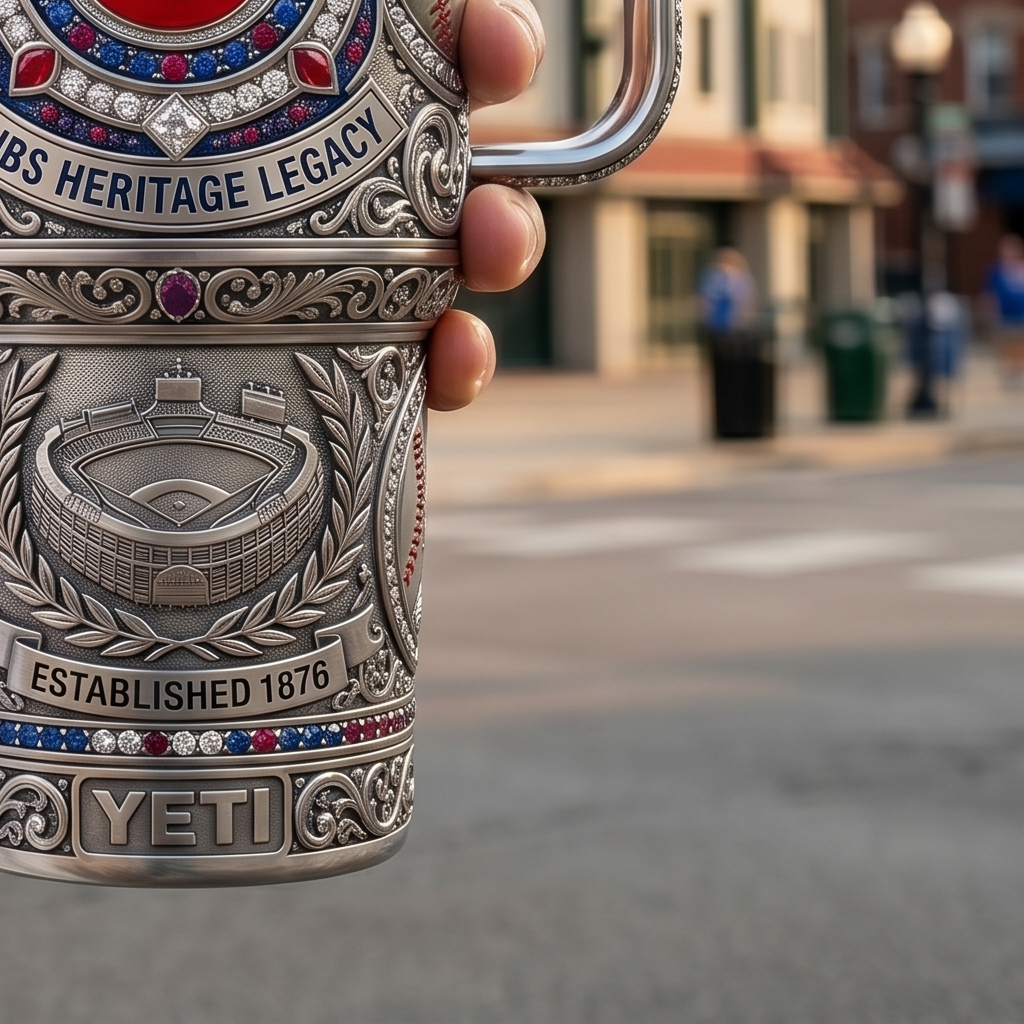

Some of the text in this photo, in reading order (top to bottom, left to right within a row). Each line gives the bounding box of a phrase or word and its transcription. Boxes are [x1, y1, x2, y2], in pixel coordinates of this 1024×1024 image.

[54, 160, 249, 215] HERITAGE
[258, 106, 385, 203] LEGACY
[30, 659, 330, 711] ESTABLISHED 1876
[91, 787, 271, 847] YETI
